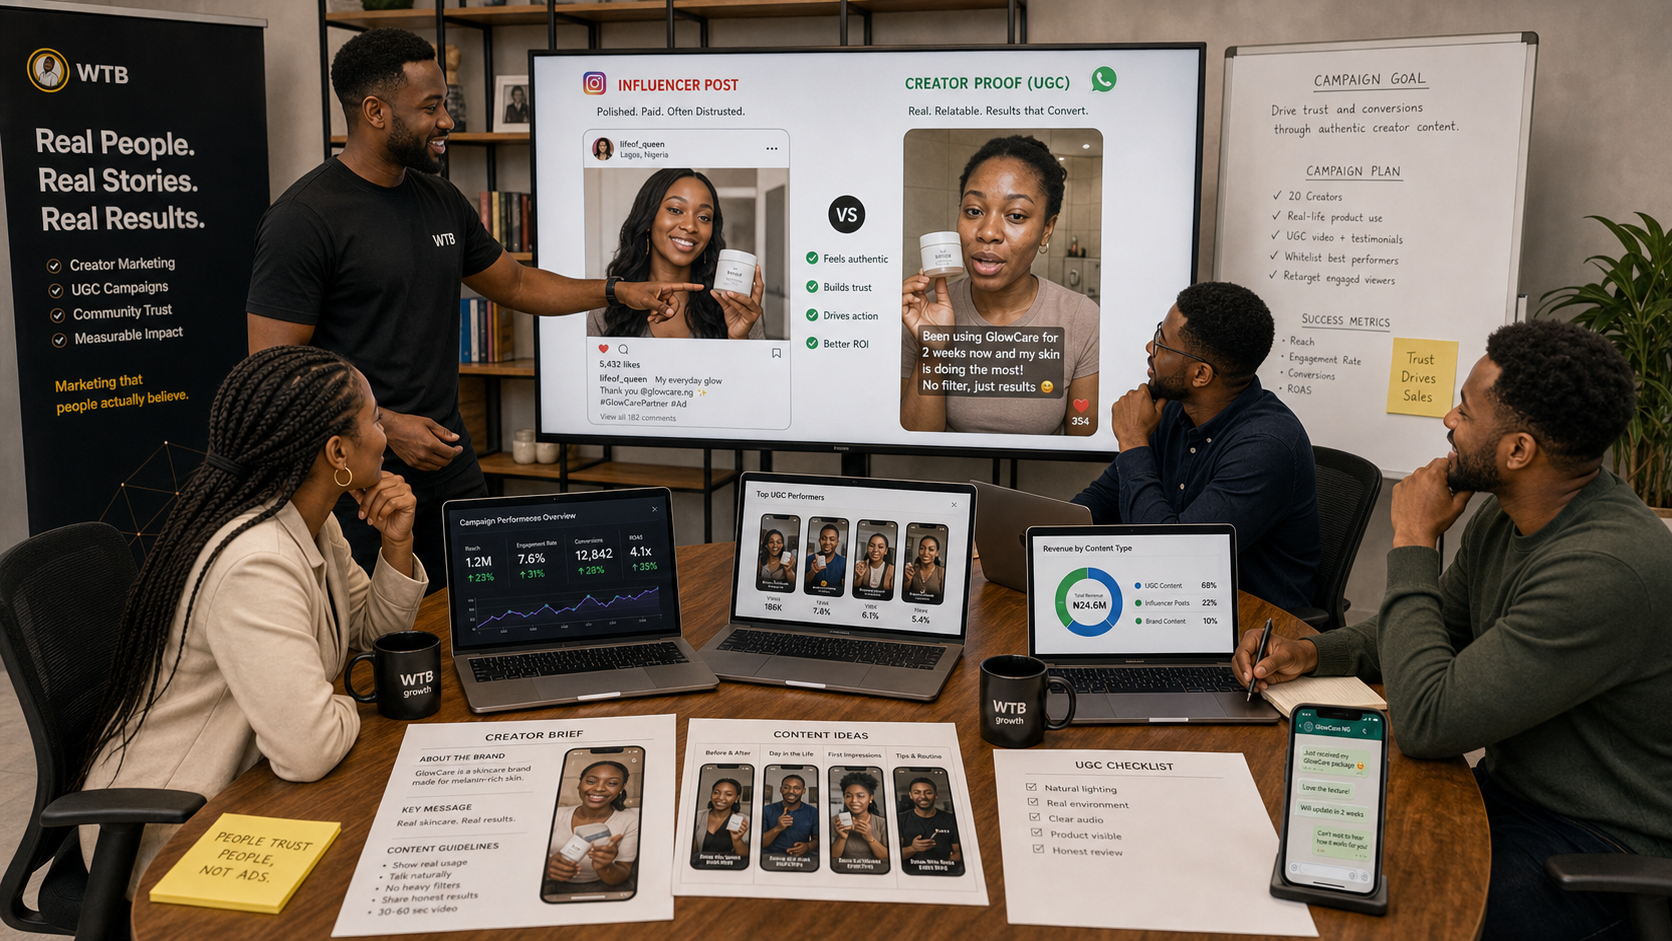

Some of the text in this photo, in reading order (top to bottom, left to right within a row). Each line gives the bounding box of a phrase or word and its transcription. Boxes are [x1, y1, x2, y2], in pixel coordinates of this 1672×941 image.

[76, 63, 129, 84] WTB
[1313, 71, 1427, 87] CAMPAIGN GOAL
[618, 79, 739, 92] INFLUENCER POST
[905, 76, 1070, 92] CREATOR PROOF (UGC)
[597, 106, 746, 116] Polished. Paid. Often Distrusted.
[908, 106, 1089, 116] Real. Relatable. Results that Convert.
[1271, 103, 1424, 117] Drive trust and conversions
[1274, 120, 1460, 139] through authentic creator content.
[36, 127, 195, 161] Real People.
[619, 140, 665, 150] lifeof_queen
[1306, 164, 1401, 177] CAMPAIGN PLAN
[39, 167, 199, 193] Real Stories.
[1288, 190, 1343, 202] 20 Creators
[41, 204, 206, 231] Real Results.
[836, 207, 858, 223] VS
[1287, 211, 1326, 222] Real-life
[1330, 212, 1364, 225] product
[432, 232, 456, 247] WTB
[1286, 231, 1307, 241] UGC
[1311, 232, 1335, 242] video
[1351, 233, 1404, 245] testimonials
[69, 256, 176, 272] Creator Marketing
[823, 254, 889, 264] Feels authentic
[1284, 251, 1399, 267] Whitelist best performers
[1283, 270, 1396, 286] Retarget engaged viewers
[72, 281, 169, 296] UGC Campaigns
[823, 282, 873, 292] Builds trust
[73, 303, 173, 321] Community Trust
[823, 311, 879, 321] Drives action
[1301, 313, 1391, 328] SUCCESS METRICS
[74, 326, 184, 345] Measurable Impact
[922, 330, 1059, 344] Been using GlowCare for
[1290, 335, 1315, 347] Reach
[823, 339, 869, 349] Better ROI
[922, 347, 1060, 362] 2 weeks now and my skin
[1289, 352, 1362, 366] Engagement Rate
[1406, 351, 1435, 366] Trust
[599, 359, 641, 370] 5,432 likes
[922, 363, 1024, 377] is doing the most!
[599, 374, 723, 386] lifeof_queen My everyday glow
[1287, 368, 1336, 381] Conversions
[1401, 370, 1437, 385] Drives
[55, 374, 143, 393] Marketing that
[922, 380, 1037, 394] No filter, just results
[1287, 384, 1313, 395] ROAS
[599, 386, 694, 398] Thank you @glowcare.ng
[1403, 389, 1433, 403] Sales
[56, 389, 189, 417] people actually believe.
[1071, 416, 1090, 426] 354
[756, 490, 825, 501] Top UGC Performers
[575, 548, 613, 562] 12,842
[629, 546, 652, 558] 4.1x
[1043, 544, 1133, 554] Revenue by Content Type
[465, 556, 492, 568] 1.2M
[517, 552, 546, 565] 7.6%
[1201, 581, 1218, 589] 68%
[1201, 599, 1218, 607] 22%
[1203, 617, 1218, 625] 10%
[400, 670, 434, 686] WTB
[403, 685, 432, 699] growth
[992, 699, 1027, 715] WTB
[995, 716, 1024, 725] growth
[485, 729, 584, 742] CREATOR BRIEF
[773, 730, 869, 740] CONTENT IDEAS
[1075, 761, 1174, 771] UGC CHECKLIST
[1045, 784, 1118, 795] Natural lighting
[1047, 799, 1129, 809] Real environment
[1048, 814, 1104, 824] Clear audio
[214, 831, 314, 852] PEOPLE TRUST
[1050, 830, 1122, 841] Product visible
[217, 848, 274, 868] PEOPLE,
[1052, 846, 1123, 857] Honest review
[199, 864, 270, 884] NOT ADS.
